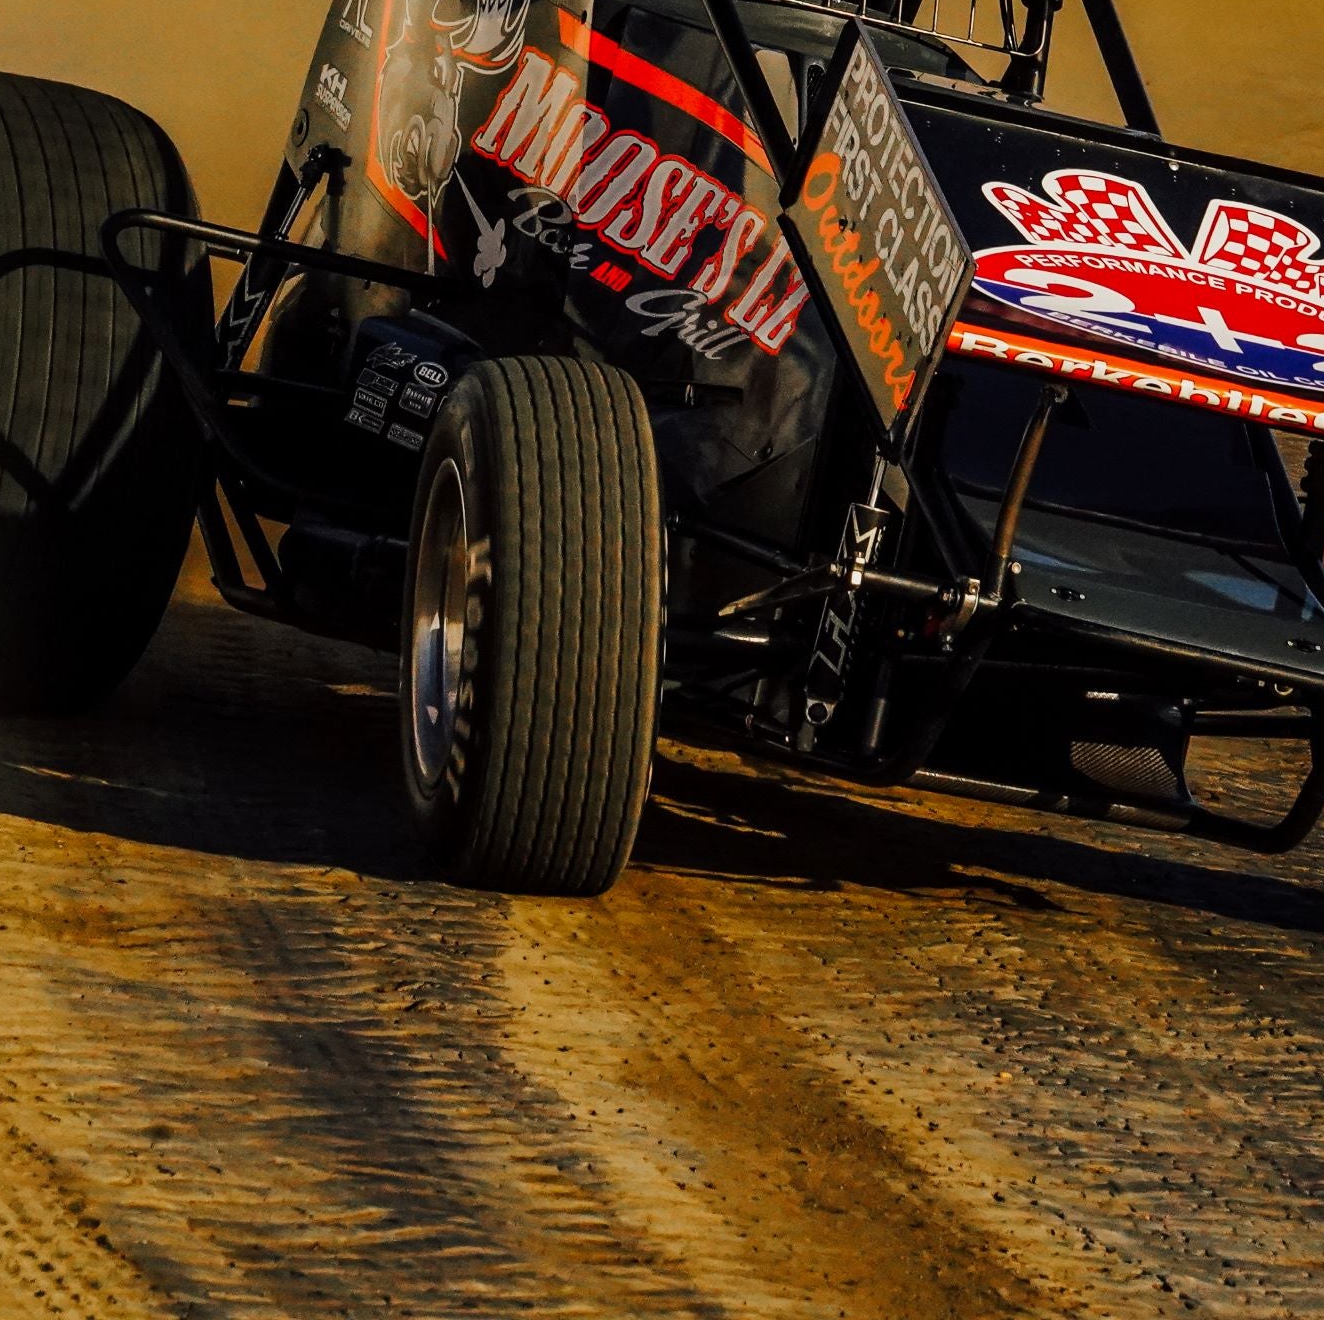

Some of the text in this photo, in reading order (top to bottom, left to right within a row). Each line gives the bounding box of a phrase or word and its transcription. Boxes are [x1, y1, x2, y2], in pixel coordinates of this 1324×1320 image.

[473, 48, 768, 305] MOOSE'S
[844, 47, 970, 312] PROTECTION
[822, 90, 943, 358] FIRST CLASS
[1013, 253, 1227, 292] PERFORMANCE
[625, 288, 751, 360] Grill
[417, 365, 444, 384] BELL
[1235, 364, 1279, 383] OIL
